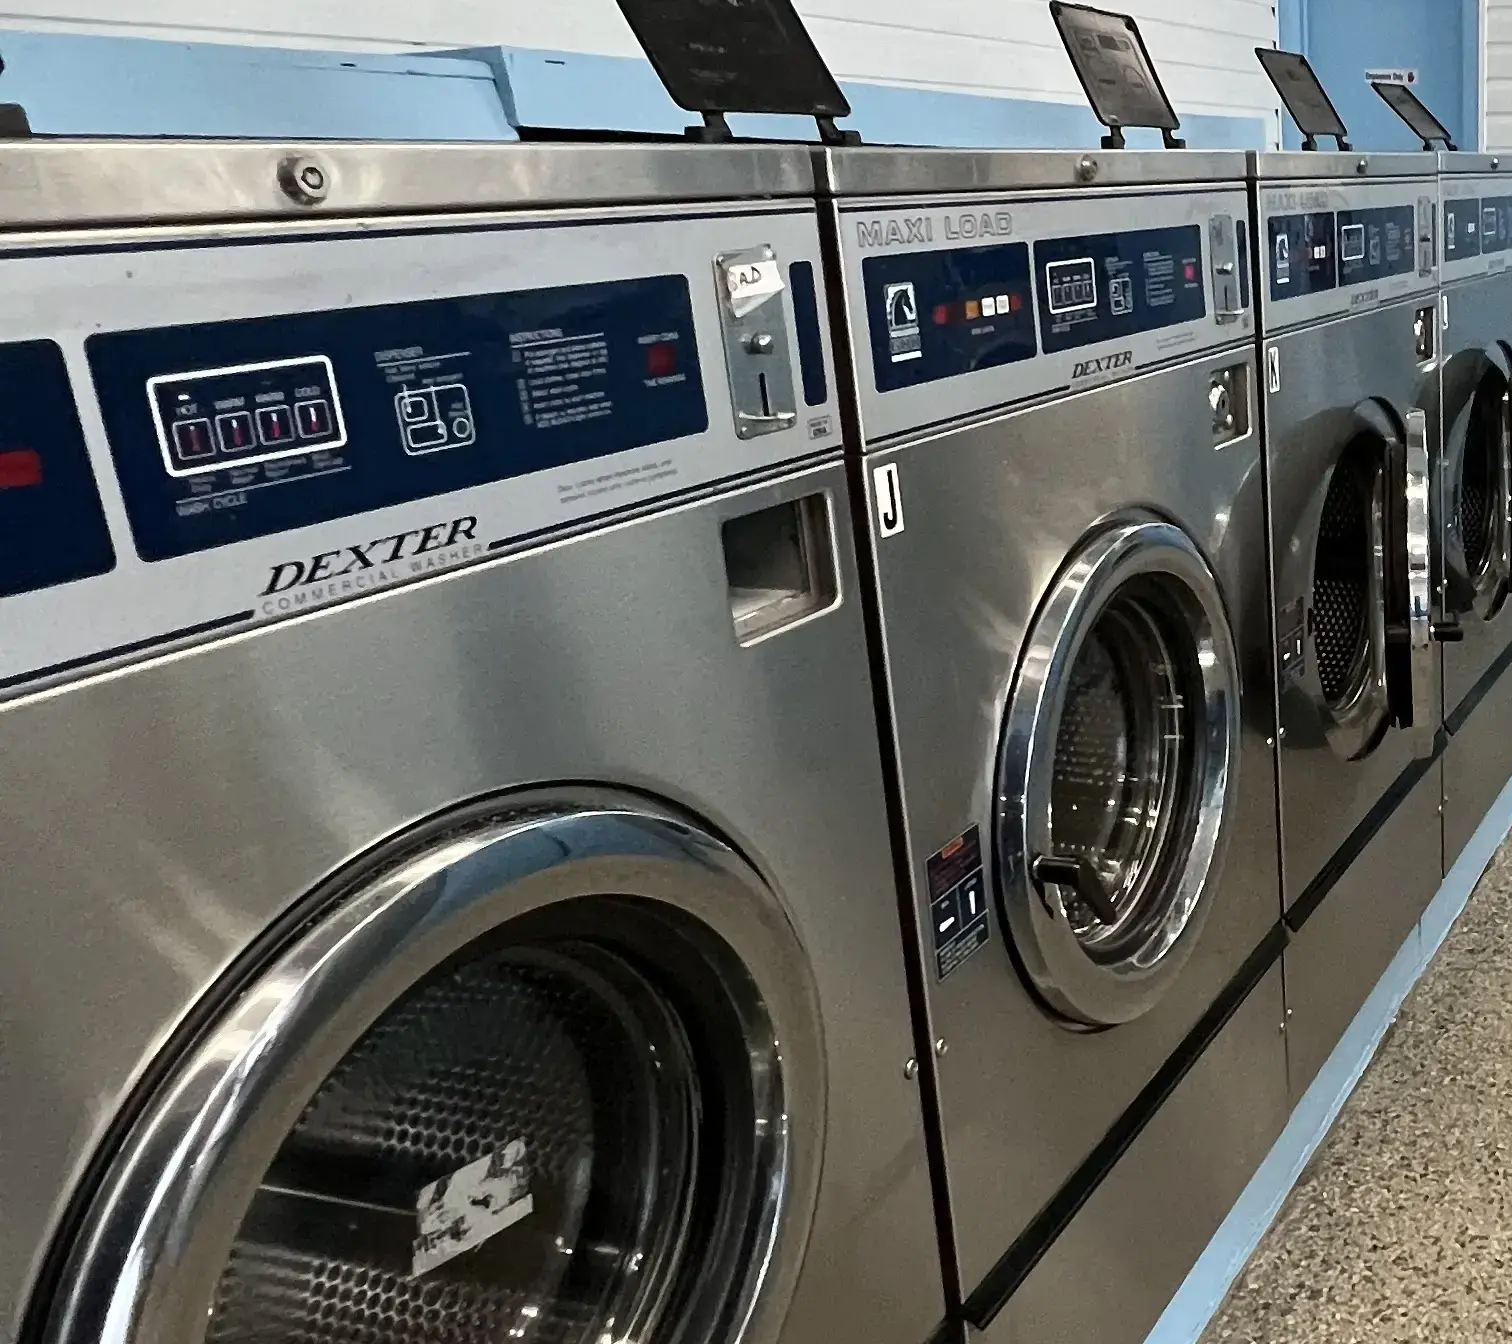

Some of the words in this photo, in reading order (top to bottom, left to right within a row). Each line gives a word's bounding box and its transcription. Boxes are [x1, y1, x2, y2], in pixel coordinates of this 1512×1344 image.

[856, 216, 933, 248] MAXI
[944, 212, 1013, 240] LOAD
[1071, 350, 1133, 380] DEXTER
[883, 469, 898, 530] J
[257, 516, 478, 597] DEXTER
[262, 567, 399, 615] COMMERCIAL
[409, 543, 483, 573] WASHER
